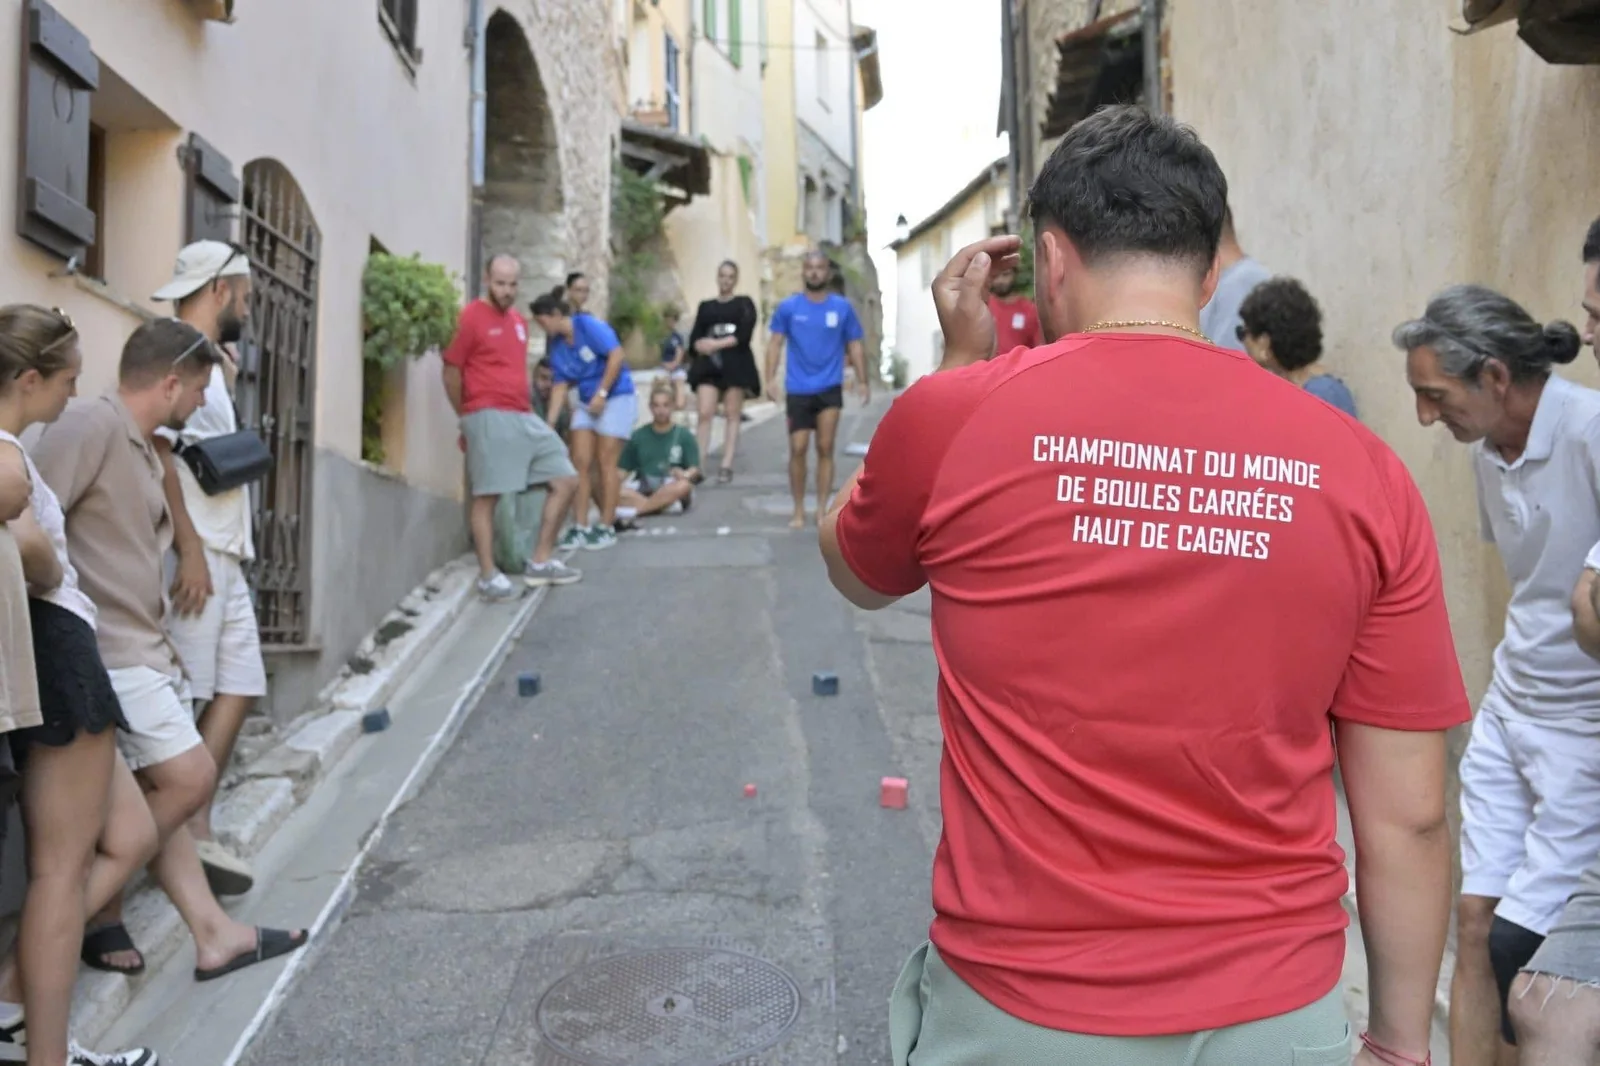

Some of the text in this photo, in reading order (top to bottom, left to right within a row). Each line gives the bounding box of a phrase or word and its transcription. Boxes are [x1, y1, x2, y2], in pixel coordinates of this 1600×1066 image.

[1033, 435, 1321, 490] CHAMPIONNAT DU MONDE
[1056, 474, 1294, 523] DE BOULES CARRÉES
[1072, 515, 1271, 560] HAUT DE CAGNES
